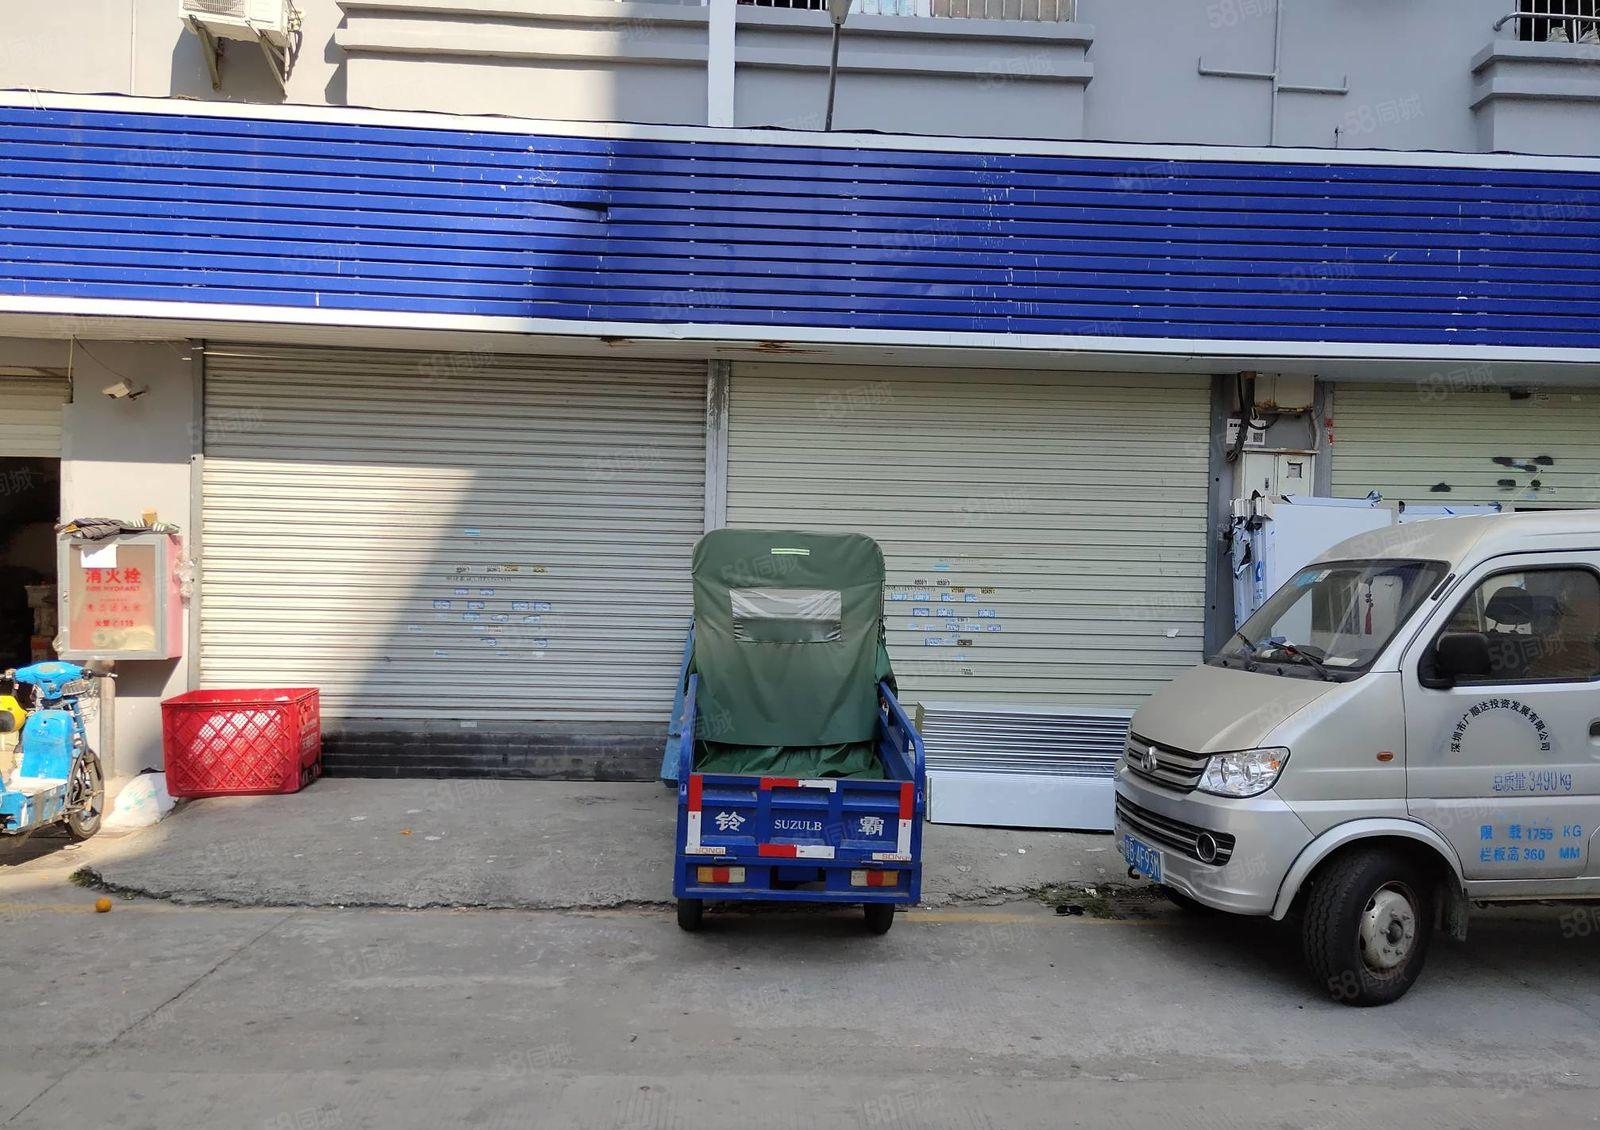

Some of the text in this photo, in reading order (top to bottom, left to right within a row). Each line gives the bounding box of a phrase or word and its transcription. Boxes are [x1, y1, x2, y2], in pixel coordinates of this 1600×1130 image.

[85, 568, 141, 583] 消火栓
[1450, 698, 1551, 753] 深圳市广顺达投资发展有限公司
[715, 811, 885, 837] 铃 SUZULB 霸
